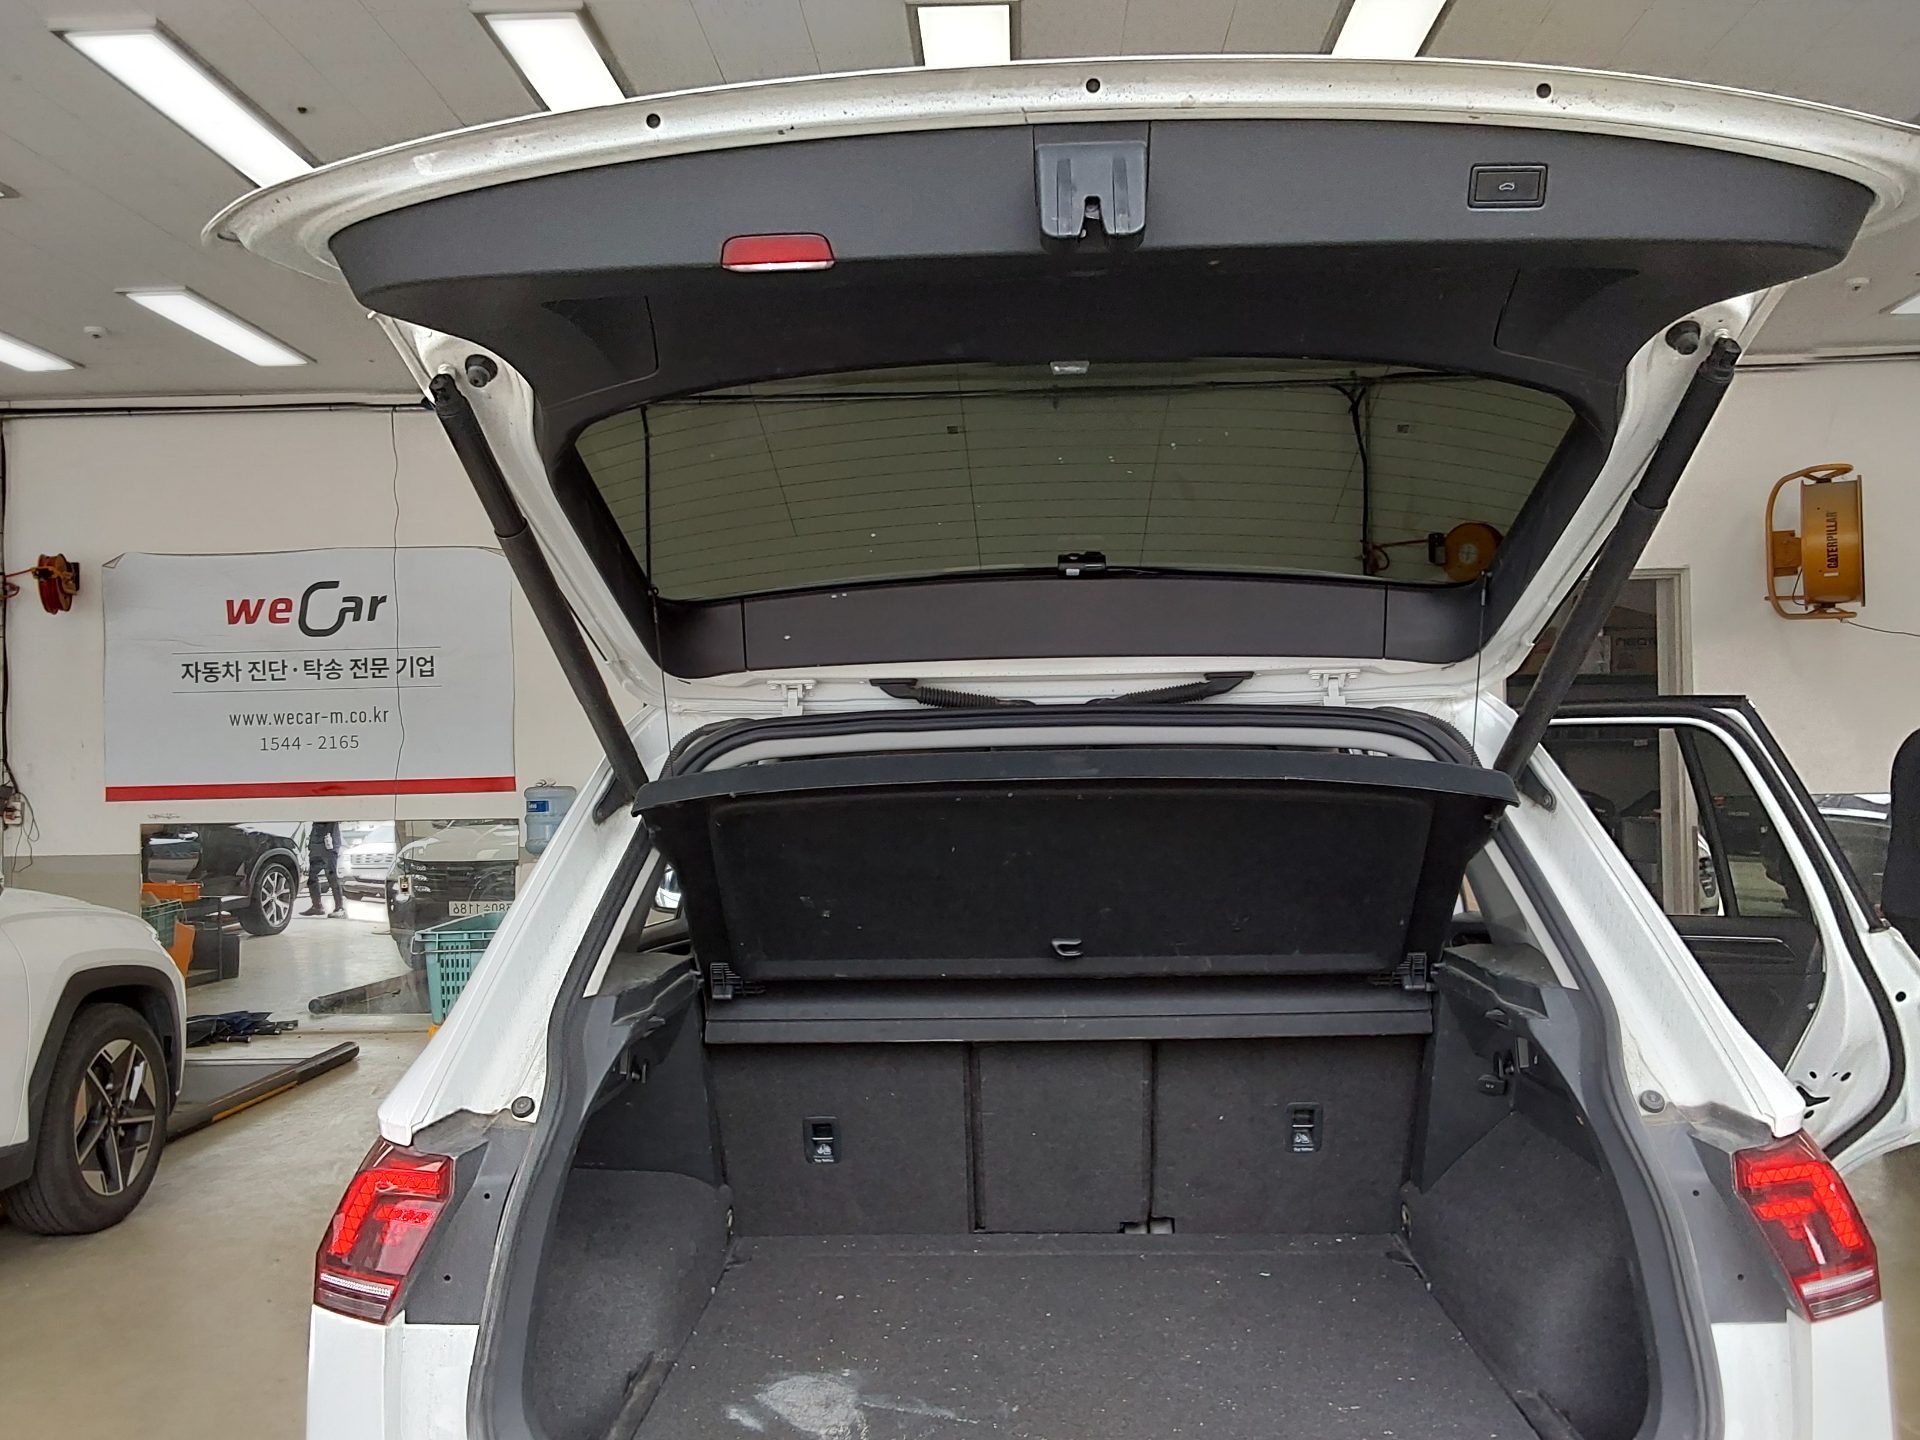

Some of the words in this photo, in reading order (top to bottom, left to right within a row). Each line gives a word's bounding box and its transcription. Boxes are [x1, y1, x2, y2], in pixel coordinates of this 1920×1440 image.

[1825, 511, 1839, 569] CATERPILLAR
[225, 580, 388, 637] weCar
[181, 661, 242, 683] 자동차
[349, 656, 390, 679] 전문
[395, 655, 434, 678] 기업
[229, 706, 389, 726] www.wecar-m.co.kr
